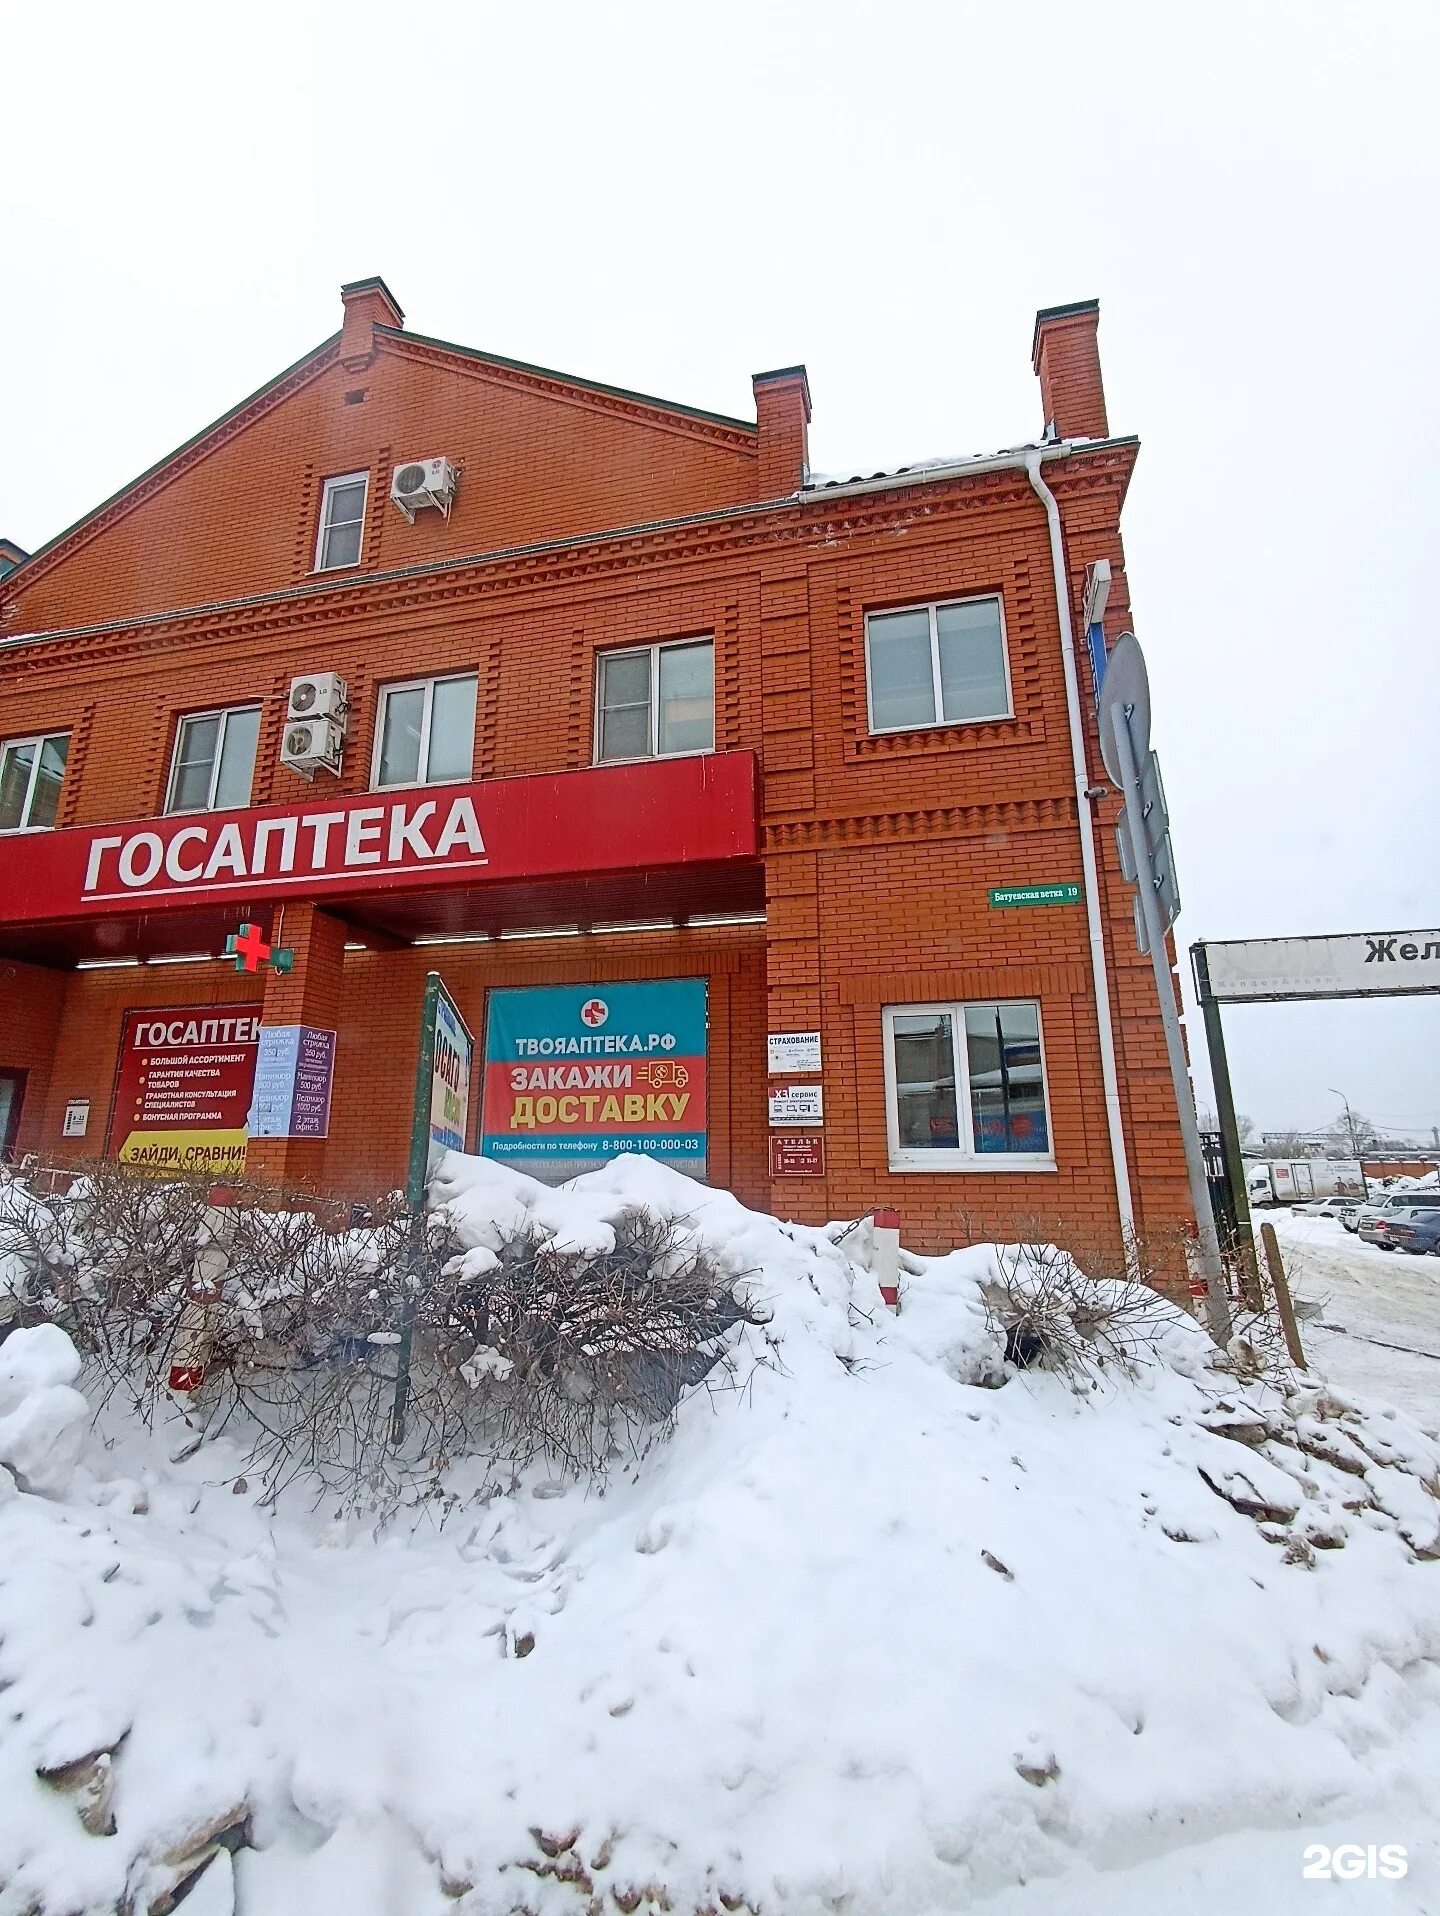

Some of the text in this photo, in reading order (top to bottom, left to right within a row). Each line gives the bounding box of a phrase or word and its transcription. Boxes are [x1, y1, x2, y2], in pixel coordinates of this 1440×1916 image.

[83, 797, 486, 891] ГОСАПТЕКА
[994, 891, 1040, 902] Батуевская
[1067, 887, 1078, 896] 19
[306, 1031, 328, 1041] Любая
[769, 1035, 819, 1045] СТРАХОВАНИЕ
[302, 1039, 330, 1050] стрижка
[515, 1033, 677, 1056] ТВОЯАПТЕКА.РФ
[305, 1048, 316, 1057] 350
[150, 1054, 246, 1066] БОЛЬШОЙ АССОРТИМЕНТ
[434, 1029, 460, 1093] ОСАГО
[148, 1069, 220, 1079] ГАРАНТИЯ КАЧЕСТВА
[296, 1071, 327, 1083] Маникюр
[510, 1064, 632, 1091] ЗАКАЖИ
[148, 1081, 180, 1089] ТОВАРОВ
[300, 1081, 311, 1090] 500
[145, 1090, 237, 1100] ГРАМОТНАЯ КОНСУЛЬТАЦИЯ
[296, 1093, 325, 1103] Педикюр
[791, 1091, 818, 1099] сервис
[144, 1101, 196, 1110] СПЕЦИАЛИСТОВ
[297, 1103, 311, 1112] 1000
[179, 1112, 222, 1120] ПРОГРАММА
[510, 1093, 690, 1129] ДОСТАВКУ
[296, 1115, 319, 1125] 2 этаж
[296, 1124, 313, 1132] офис
[492, 1141, 545, 1151] Подробности
[558, 1141, 598, 1151] телефону
[602, 1139, 699, 1150] 8-800-100-000-03
[184, 1146, 246, 1161] СРАВНИ!
